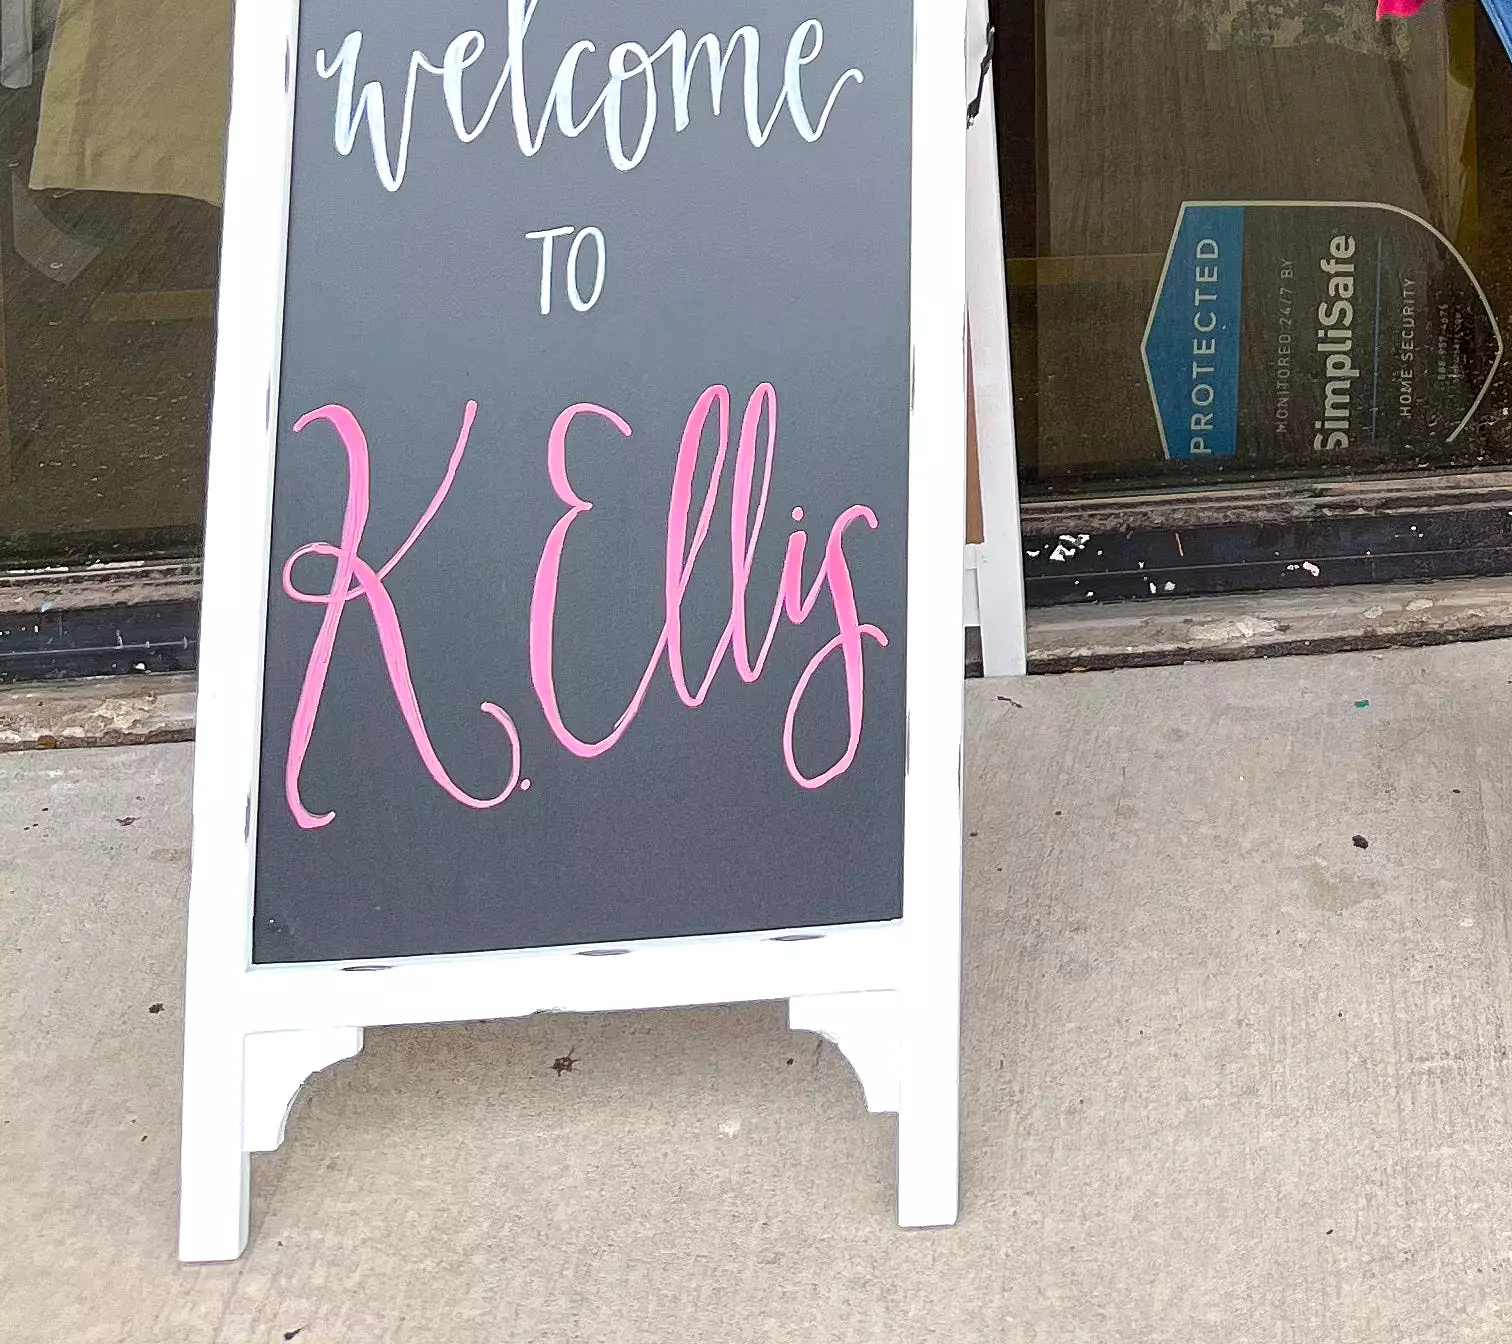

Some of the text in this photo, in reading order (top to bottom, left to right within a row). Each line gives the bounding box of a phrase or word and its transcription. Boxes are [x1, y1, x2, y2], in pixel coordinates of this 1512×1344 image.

[525, 225, 607, 315] TO
[1190, 238, 1219, 455] PROTECTED
[1275, 257, 1294, 434] MONITORED 24/7 BY
[1313, 234, 1360, 451] SimpliSafe
[1399, 278, 1417, 417] HOME SECURITY
[283, 381, 888, 828] K. Ellis
